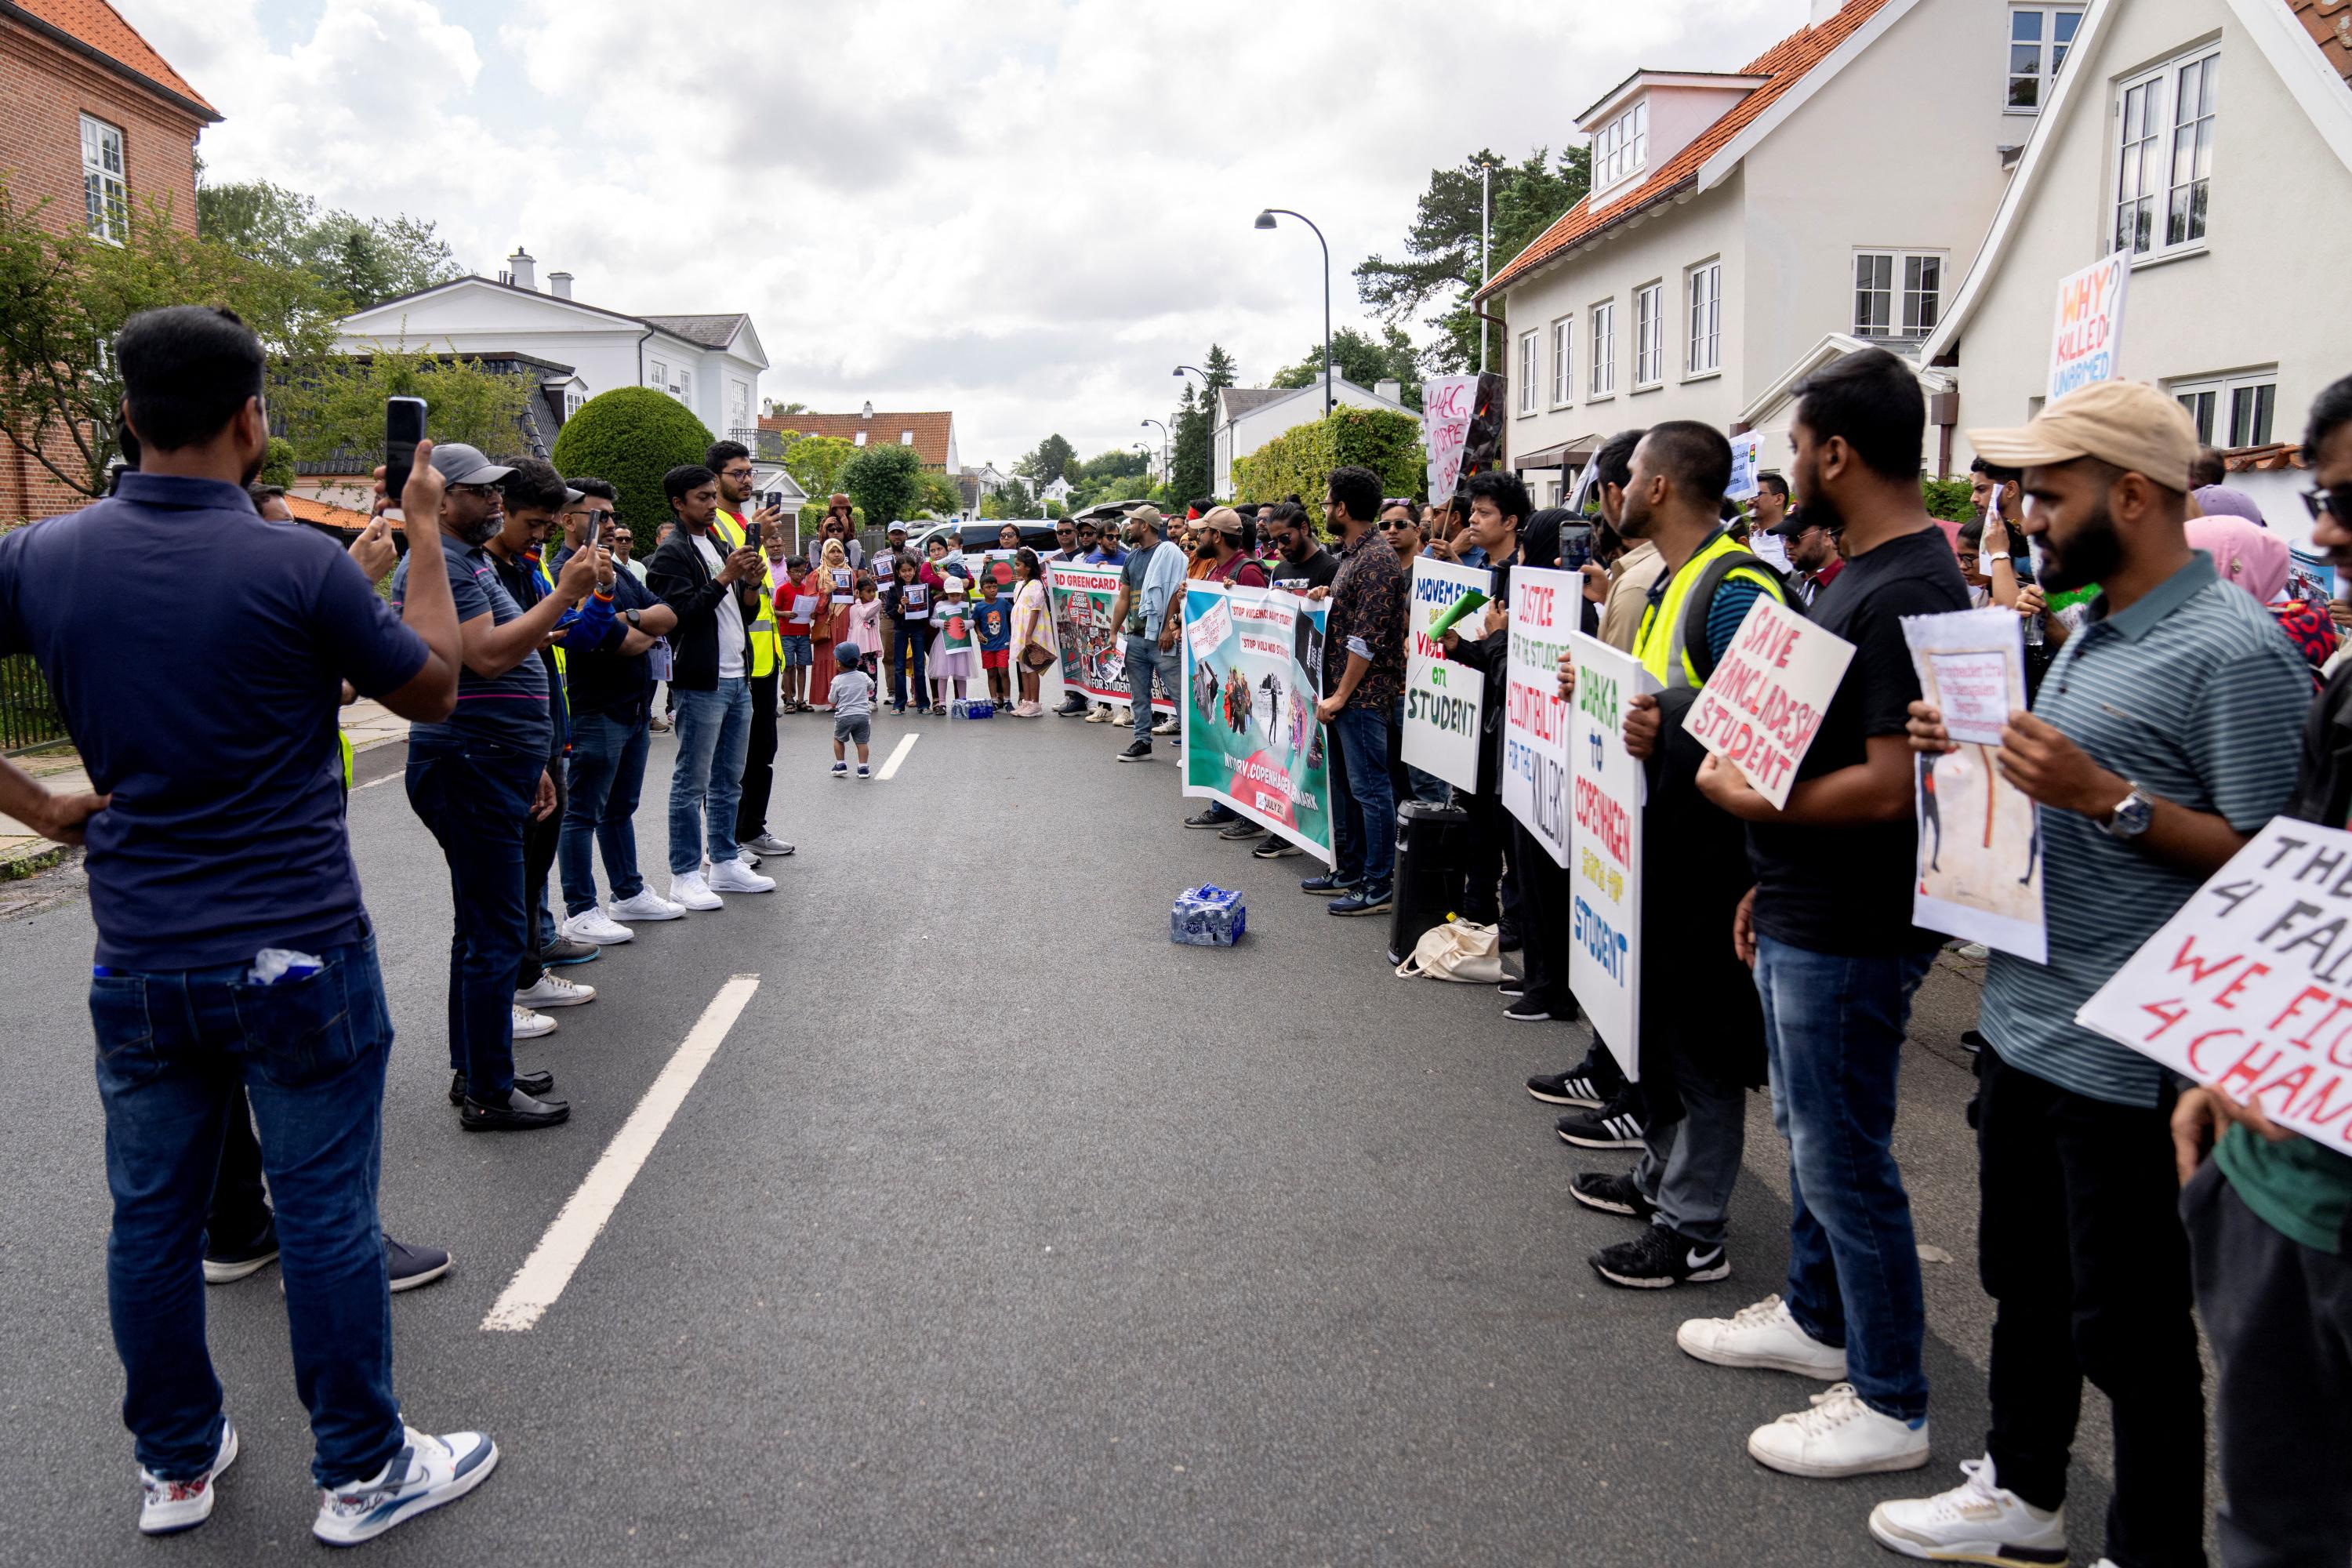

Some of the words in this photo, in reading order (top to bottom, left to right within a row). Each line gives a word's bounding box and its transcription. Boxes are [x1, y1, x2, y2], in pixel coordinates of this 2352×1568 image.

[2056, 314, 2107, 367] KILLED
[1730, 477, 1742, 486] nts.
[1732, 451, 1749, 461] ocide
[1416, 578, 1483, 615] MOVEMET
[1517, 583, 1555, 627] JUSTICE
[1742, 606, 1802, 669] SAVE
[1091, 677, 1103, 690] FOR
[1105, 681, 1132, 694] STUDENT
[1432, 666, 1446, 688] on
[1580, 665, 1619, 736] DHAKA
[1407, 687, 1477, 739] STUDENT
[1589, 727, 1604, 773] TO
[1693, 696, 1792, 790] STUDENT
[1531, 749, 1565, 849] KILLERS
[1575, 774, 1632, 873] COPENHAGEN
[1574, 895, 1628, 988] STUDENT
[2209, 880, 2264, 918] 4
[2256, 899, 2352, 988] FAI
[2168, 935, 2273, 1010] WE
[2139, 997, 2190, 1042] 4
[2187, 1028, 2352, 1143] CHAN
